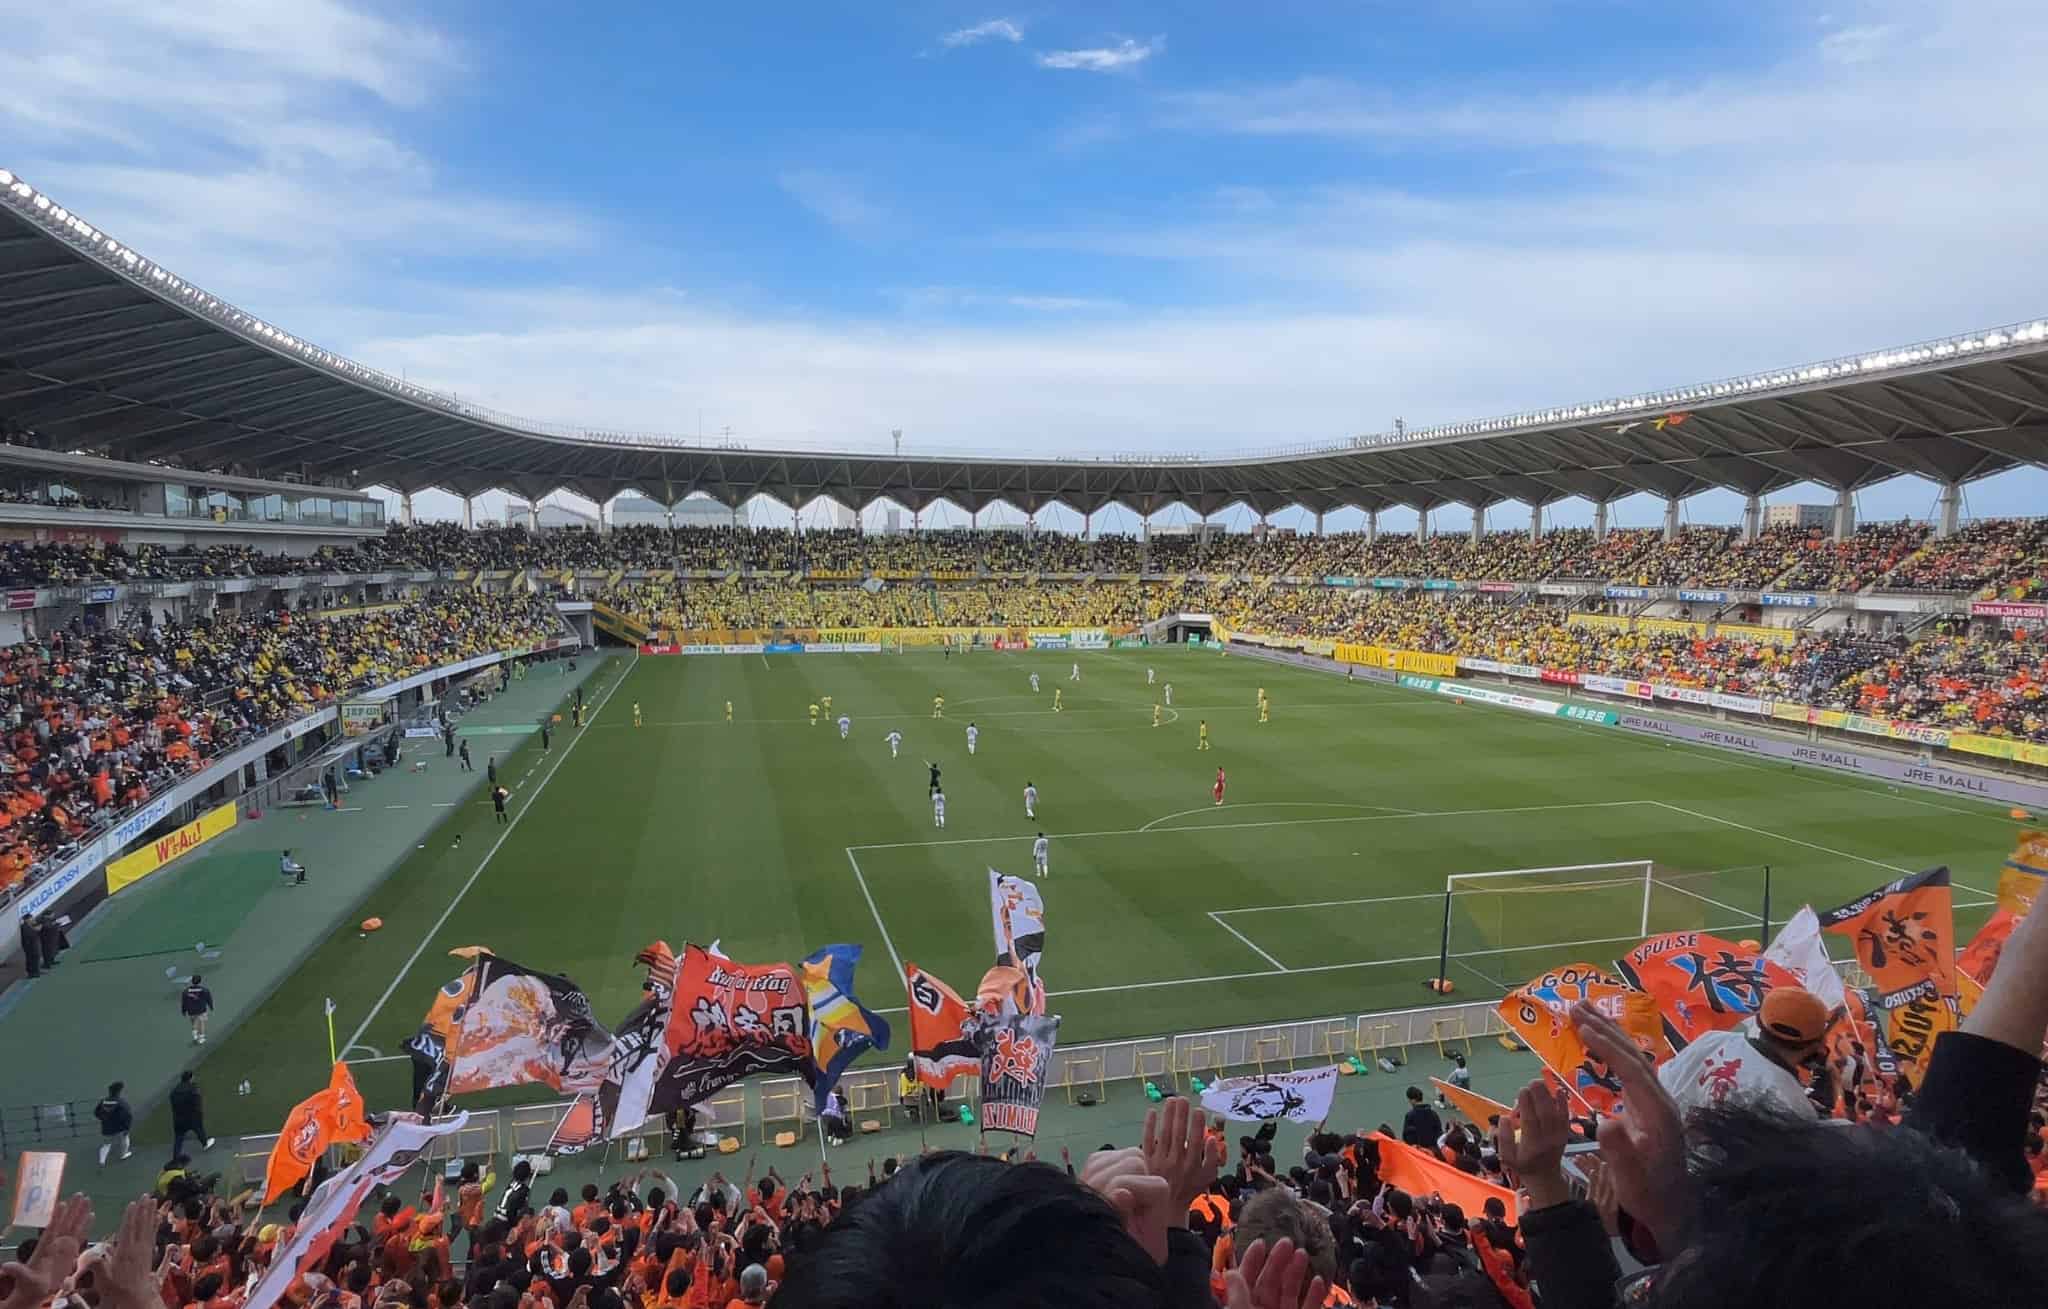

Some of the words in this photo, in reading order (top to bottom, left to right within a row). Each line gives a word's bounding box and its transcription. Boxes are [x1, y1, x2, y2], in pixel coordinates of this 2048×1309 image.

[1622, 717, 1641, 727] JRE
[1643, 720, 1673, 733] MALL
[1700, 731, 1721, 741] JRE
[1724, 735, 1760, 749] MALL
[1792, 748, 1818, 760] JRE
[1821, 752, 1863, 769] MALL
[1904, 767, 1935, 782] JRE
[1939, 773, 1990, 793] MALL
